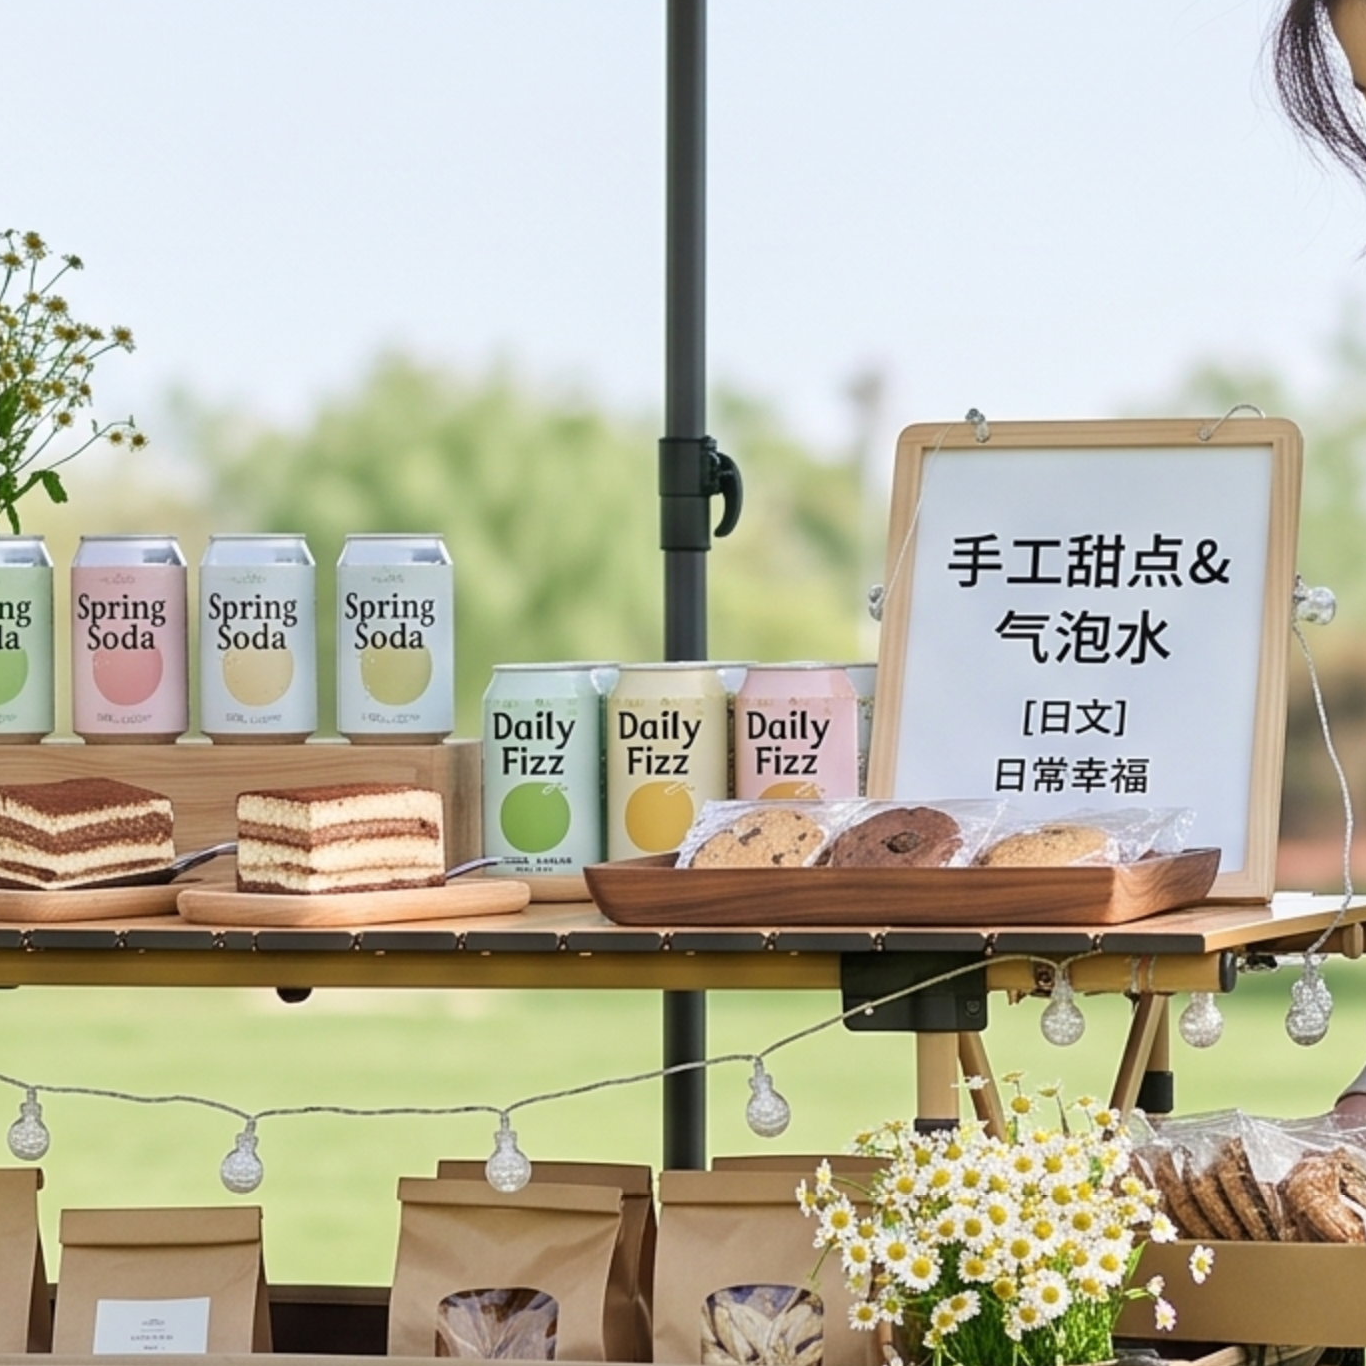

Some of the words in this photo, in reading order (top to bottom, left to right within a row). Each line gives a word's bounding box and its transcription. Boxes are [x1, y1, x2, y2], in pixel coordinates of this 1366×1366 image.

[948, 533, 1231, 588] 手工甜点&
[77, 593, 166, 627] Spring
[208, 592, 298, 626] Spring
[344, 592, 435, 626] Spring
[87, 623, 156, 651] Soda
[217, 623, 287, 650] Soda
[354, 621, 425, 650] Soda
[995, 609, 1171, 665] 气泡水
[492, 710, 576, 750] Daily
[618, 710, 702, 750] Daily
[746, 710, 830, 750] Daily
[1023, 698, 1126, 737] [日文]
[502, 746, 565, 776] Fizz
[627, 746, 691, 776] Fizz
[755, 746, 819, 776] Fizz
[995, 757, 1150, 794] 日常幸福
